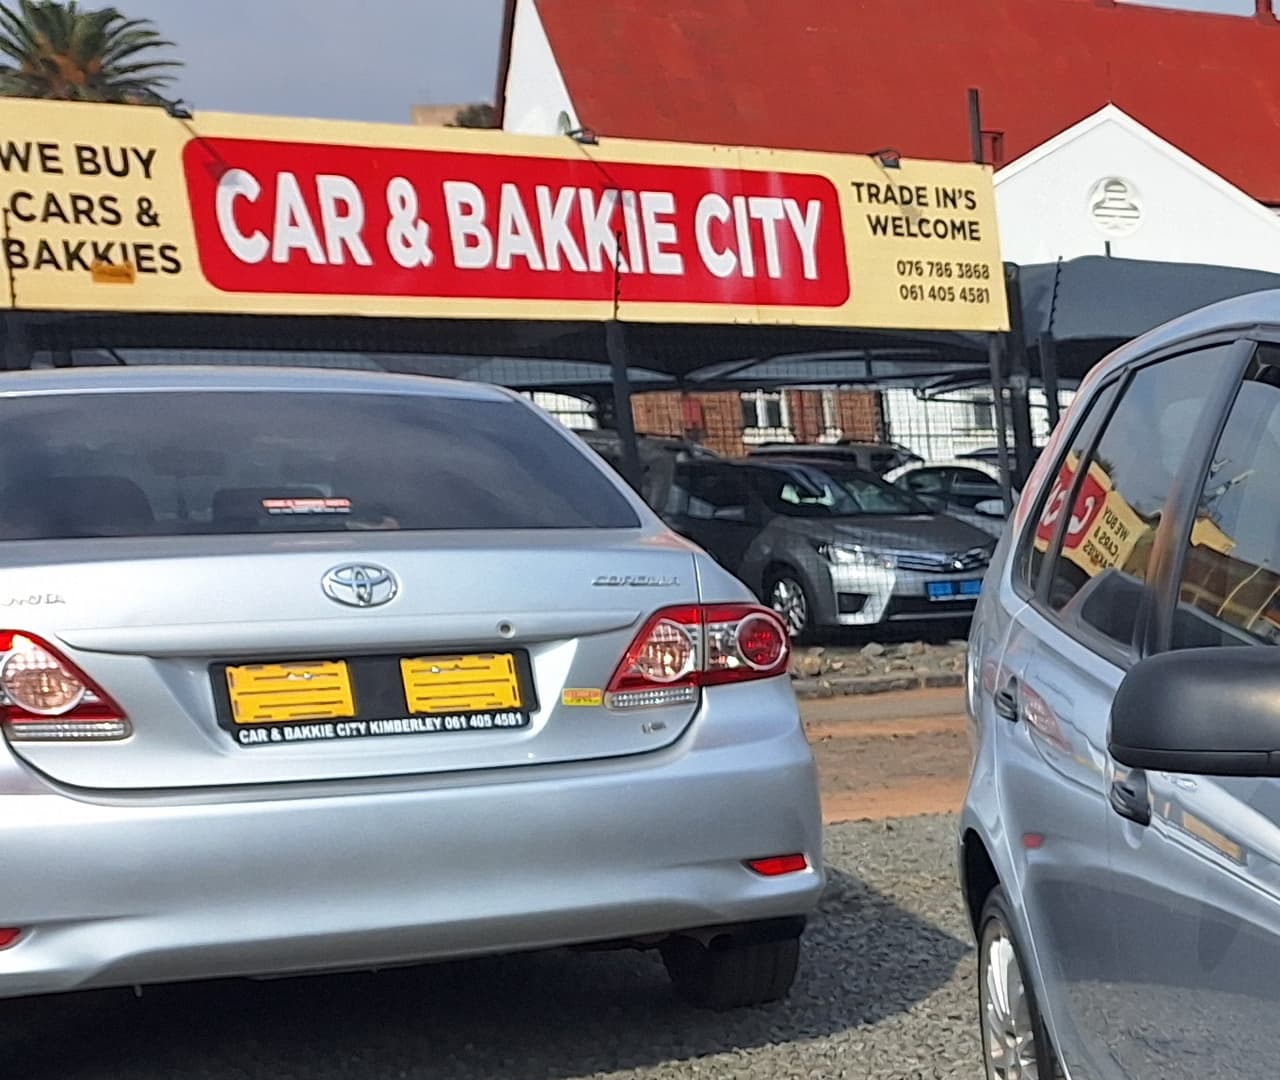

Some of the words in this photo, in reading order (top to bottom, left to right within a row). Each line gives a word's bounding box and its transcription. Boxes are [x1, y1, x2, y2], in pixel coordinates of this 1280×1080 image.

[0, 141, 64, 175] WE
[74, 143, 157, 179] BUY
[10, 190, 122, 225] CARS
[136, 196, 160, 227] &
[851, 182, 929, 207] TRADE
[935, 187, 977, 211] IN'S
[215, 168, 372, 265] CAR
[386, 176, 432, 267] &
[443, 180, 684, 275] BAKKIE
[695, 193, 821, 279] CITY
[867, 214, 981, 241] WELCOME
[2, 238, 182, 274] BAKKIES
[897, 260, 924, 277] 076
[927, 261, 953, 279] 786
[956, 263, 990, 280] 3868
[900, 284, 925, 301] 061
[928, 286, 955, 302] 405
[959, 287, 990, 304] 4581
[239, 729, 268, 744] CAR
[270, 728, 282, 742] &
[285, 724, 335, 741] BAKKIE
[337, 721, 367, 737] CITY
[369, 718, 442, 735] KIMBERLEY
[444, 715, 467, 730] 061
[470, 714, 492, 728] 405
[494, 712, 523, 727] 4581
